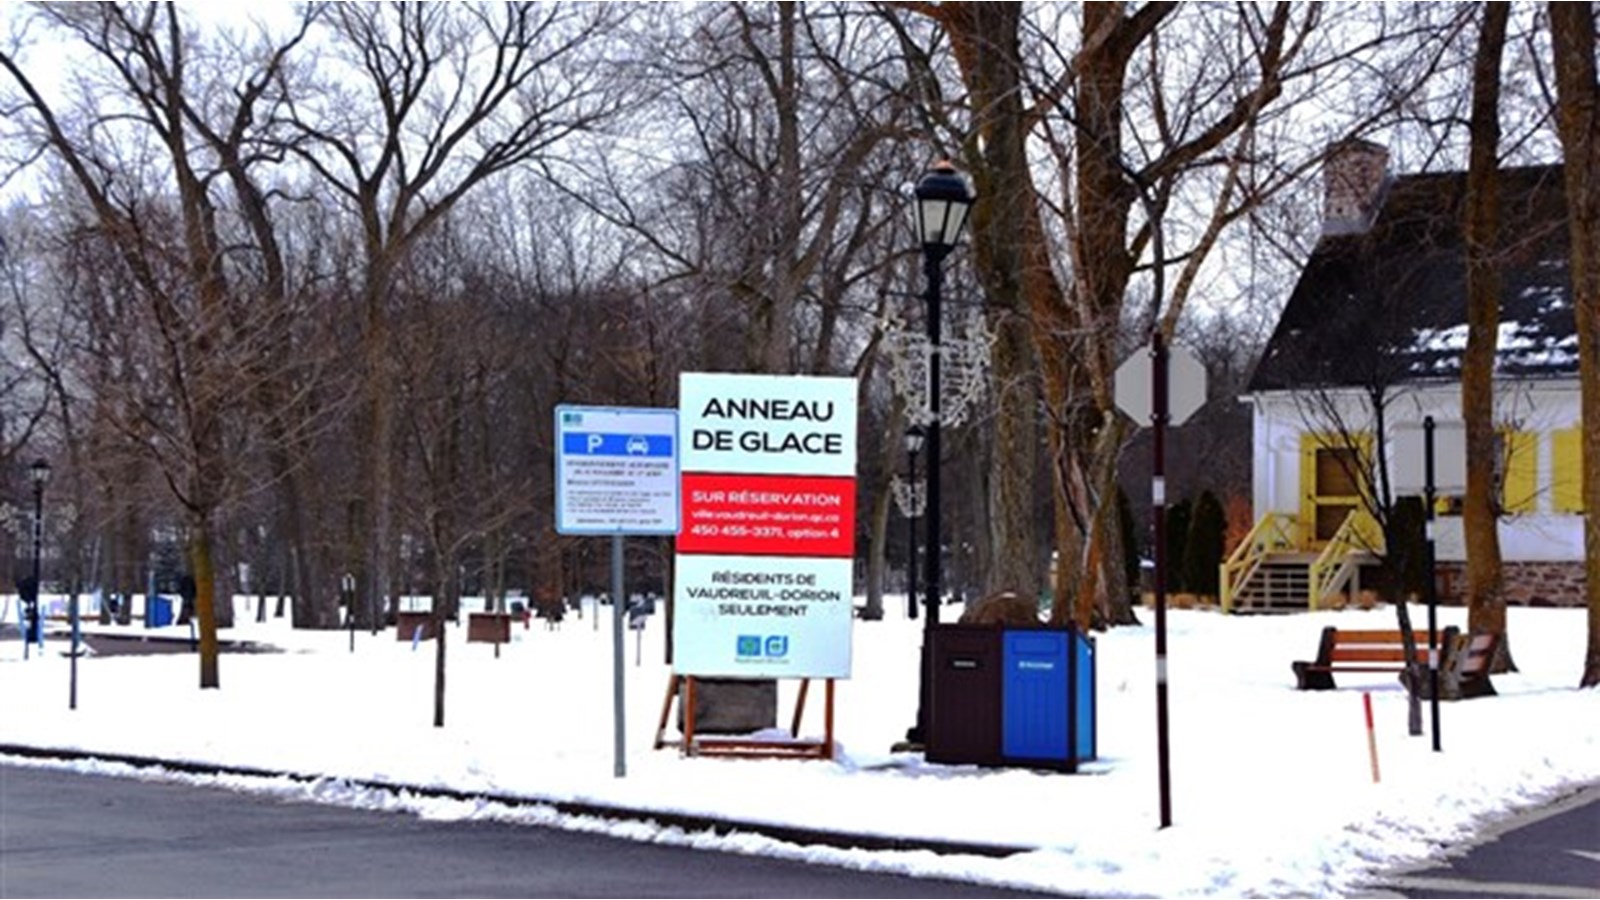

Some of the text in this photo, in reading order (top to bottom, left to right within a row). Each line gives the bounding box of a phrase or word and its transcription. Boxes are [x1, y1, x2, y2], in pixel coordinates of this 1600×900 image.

[702, 397, 834, 422] ANNEAU
[587, 434, 603, 453] P
[692, 429, 843, 454] DE GLACE
[691, 489, 841, 506] SUR RÉSERVATION
[691, 524, 718, 536] 450
[787, 528, 828, 540] option
[711, 570, 816, 586] RÉSIDENTS DE
[686, 587, 841, 602] VAUDREUIL-DORION
[718, 604, 808, 617] SEULEMENT
